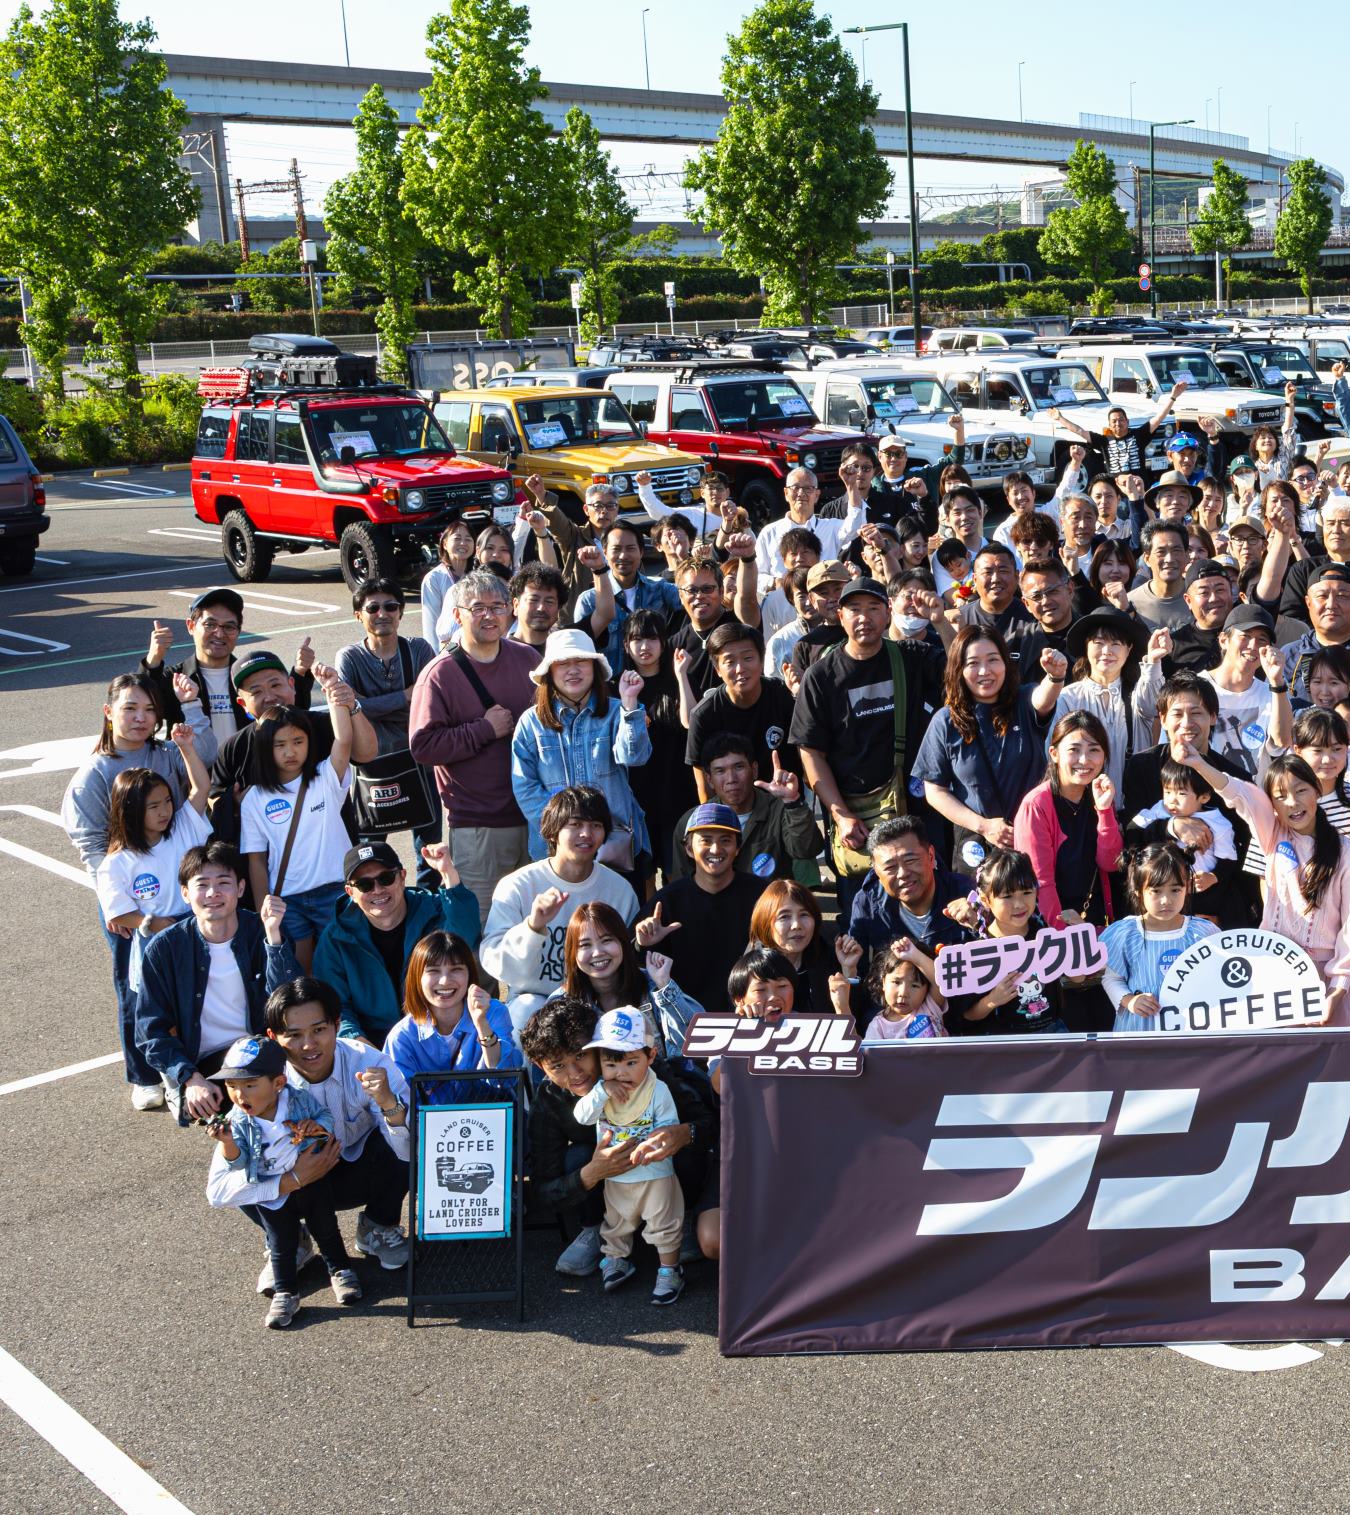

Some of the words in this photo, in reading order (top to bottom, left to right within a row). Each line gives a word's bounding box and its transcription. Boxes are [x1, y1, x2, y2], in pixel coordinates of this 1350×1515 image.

[856, 708, 872, 717] LAND
[1246, 725, 1264, 739] GUEST
[374, 787, 399, 800] ARB
[267, 801, 286, 812] GUEST
[376, 796, 410, 808] ACCESSORIES
[753, 854, 769, 870] GUEST
[135, 877, 153, 887] GUEST
[942, 929, 1102, 990] #ランクル
[1167, 946, 1212, 993] LAND
[1220, 934, 1308, 978] CRUISER
[1159, 986, 1324, 1032] COFFEE
[909, 1016, 930, 1034] GUEST
[687, 1018, 857, 1053] ランクル
[754, 1056, 858, 1071] BASE
[440, 1121, 458, 1138] LAND
[461, 1119, 491, 1137] CRUISER
[437, 1140, 494, 1153] COFFEE
[441, 1199, 464, 1208] ONLY
[469, 1198, 488, 1207] FOR
[429, 1209, 455, 1219] LAND
[458, 1208, 500, 1218] CRUISER
[446, 1218, 483, 1228] LOVERS
